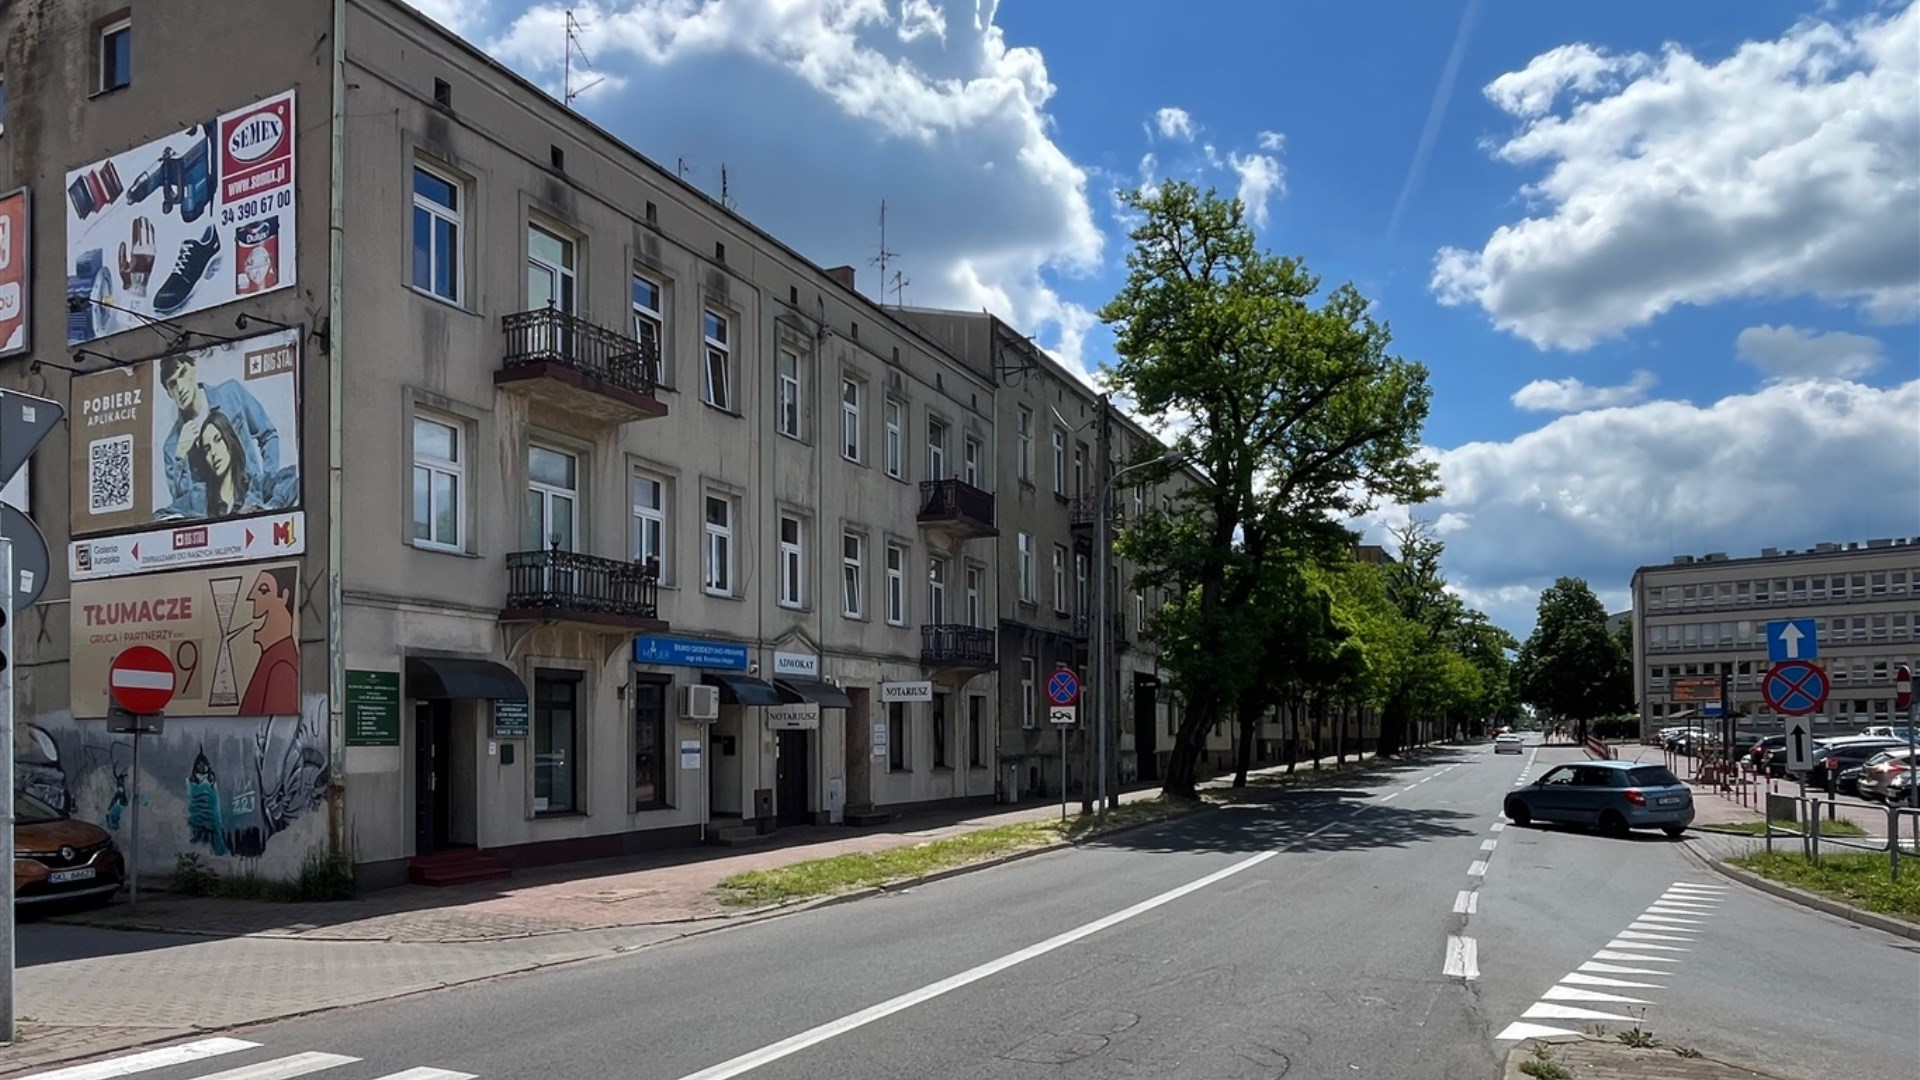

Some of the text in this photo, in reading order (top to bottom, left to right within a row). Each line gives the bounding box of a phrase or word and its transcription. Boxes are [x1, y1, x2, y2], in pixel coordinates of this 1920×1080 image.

[231, 120, 279, 152] SEMEX
[221, 189, 290, 226] 34 390 67 00
[263, 349, 293, 372] BIG STA
[83, 389, 142, 415] POBIERZ
[87, 407, 137, 427] APLIKACJĘ
[93, 545, 119, 554] Galeria
[83, 596, 192, 626] TŁUMACZE
[89, 633, 118, 644] GRUCA
[124, 629, 173, 641] PARTNERZY
[778, 658, 815, 670] ADWOKAT
[885, 686, 928, 697] NOTARIUSZ
[769, 711, 817, 721] NOTARIUSZ
